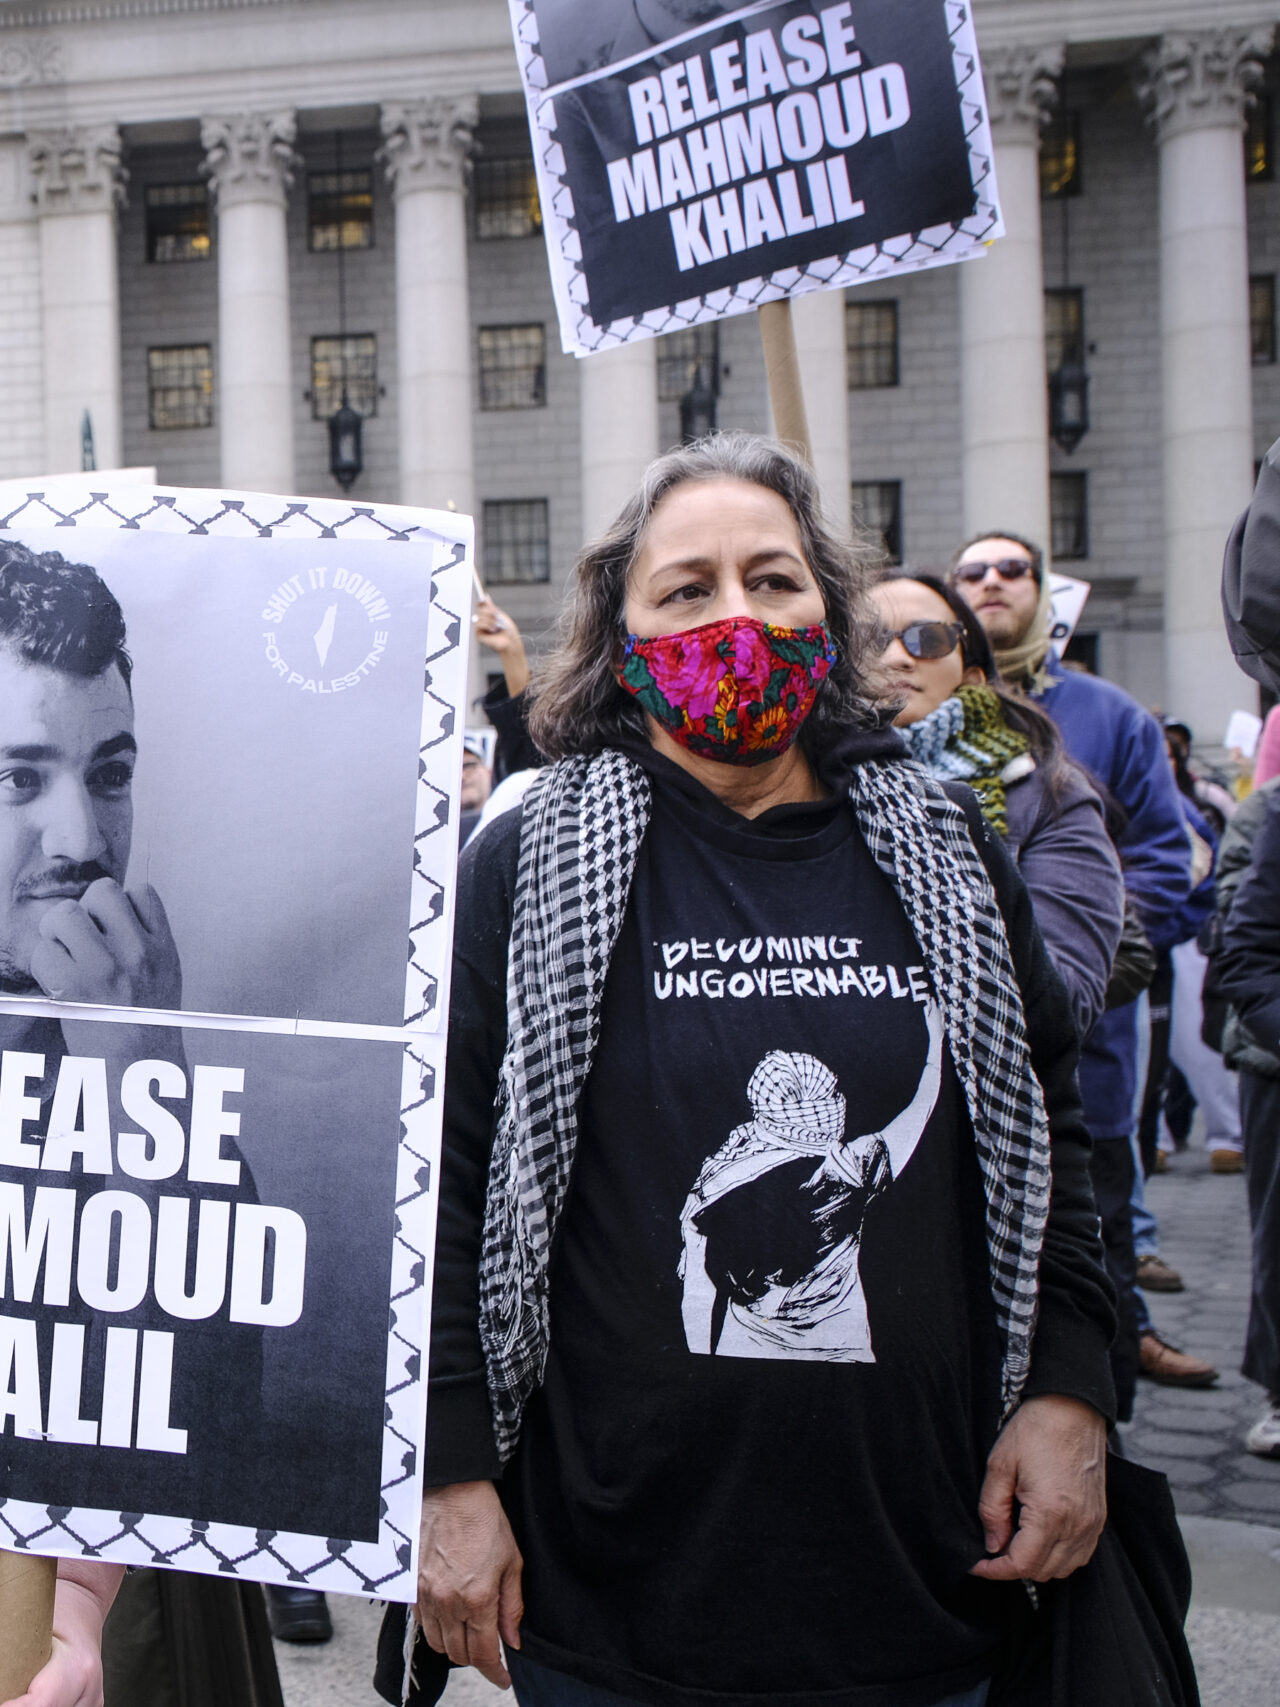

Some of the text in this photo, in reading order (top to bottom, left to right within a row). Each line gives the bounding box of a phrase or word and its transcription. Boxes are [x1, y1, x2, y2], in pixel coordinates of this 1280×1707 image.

[627, 2, 862, 146] RELEASE
[606, 62, 912, 223] MAHMOUD
[669, 154, 865, 272] KHALIL
[261, 567, 391, 624] SHUT IT DOWN!
[262, 630, 389, 694] FOR PALESTINE
[653, 964, 930, 1002] UNGOVERNABLE
